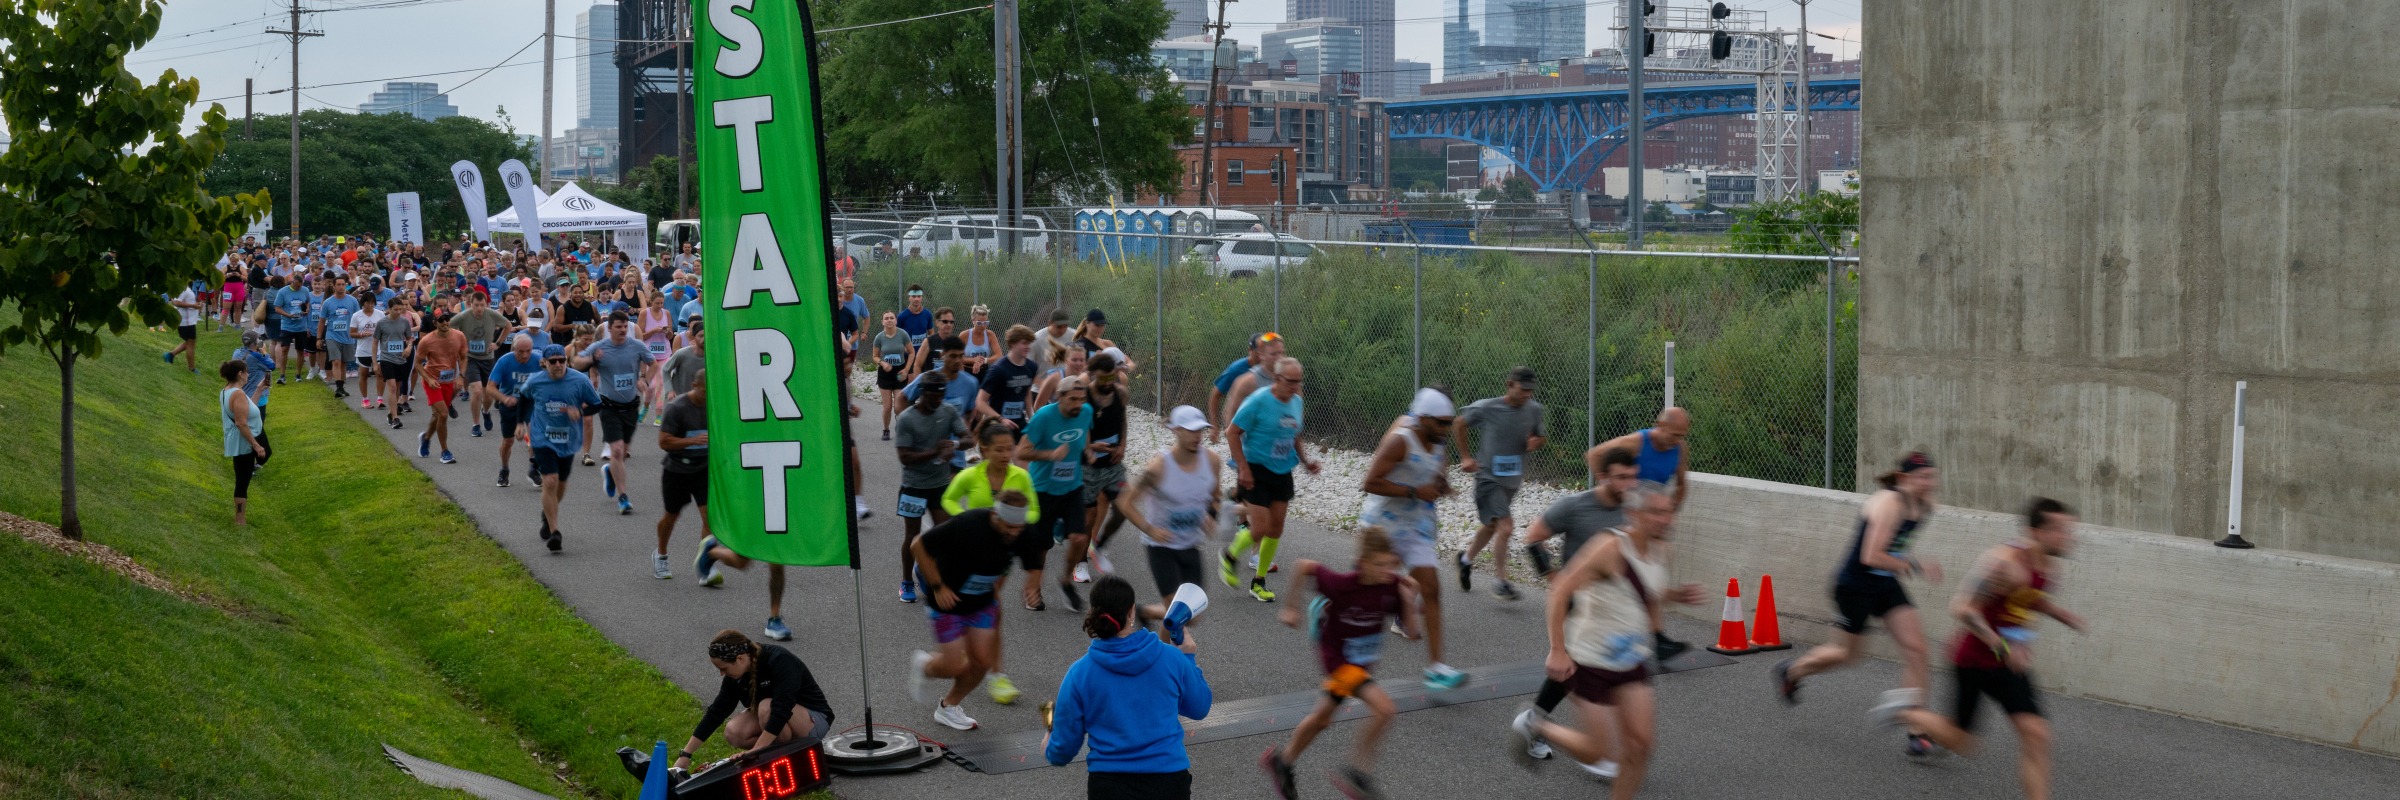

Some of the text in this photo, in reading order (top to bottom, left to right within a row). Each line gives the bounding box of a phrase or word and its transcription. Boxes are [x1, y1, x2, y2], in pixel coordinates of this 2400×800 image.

[542, 219, 629, 228] CROSSCOUNTRY MORTGAGE
[707, 0, 803, 536] START
[742, 749, 820, 800] 0:01
